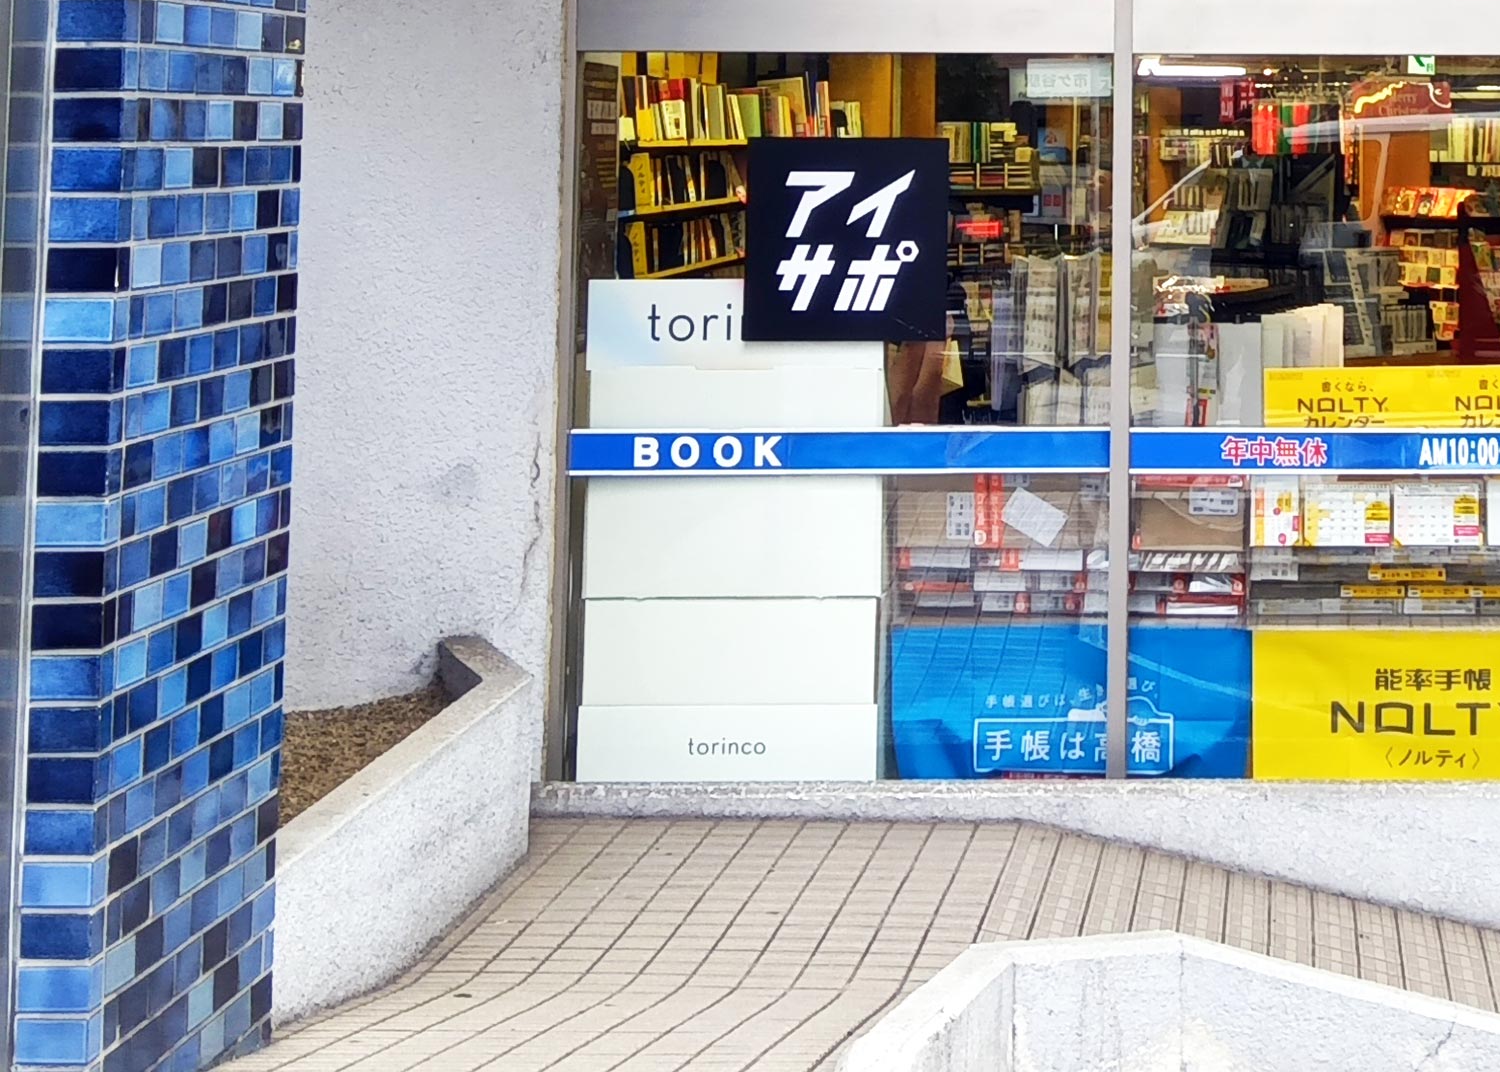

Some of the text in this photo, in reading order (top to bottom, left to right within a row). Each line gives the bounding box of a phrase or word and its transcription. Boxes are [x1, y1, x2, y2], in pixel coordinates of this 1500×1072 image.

[785, 169, 917, 238] アイ
[776, 240, 920, 311] サポ
[647, 303, 744, 342] tori
[1297, 396, 1388, 414] NOLTY
[633, 435, 783, 468] BOOK
[1220, 435, 1328, 467] 年中無休
[1375, 668, 1492, 691] 能率手帳
[687, 736, 767, 756] torinco
